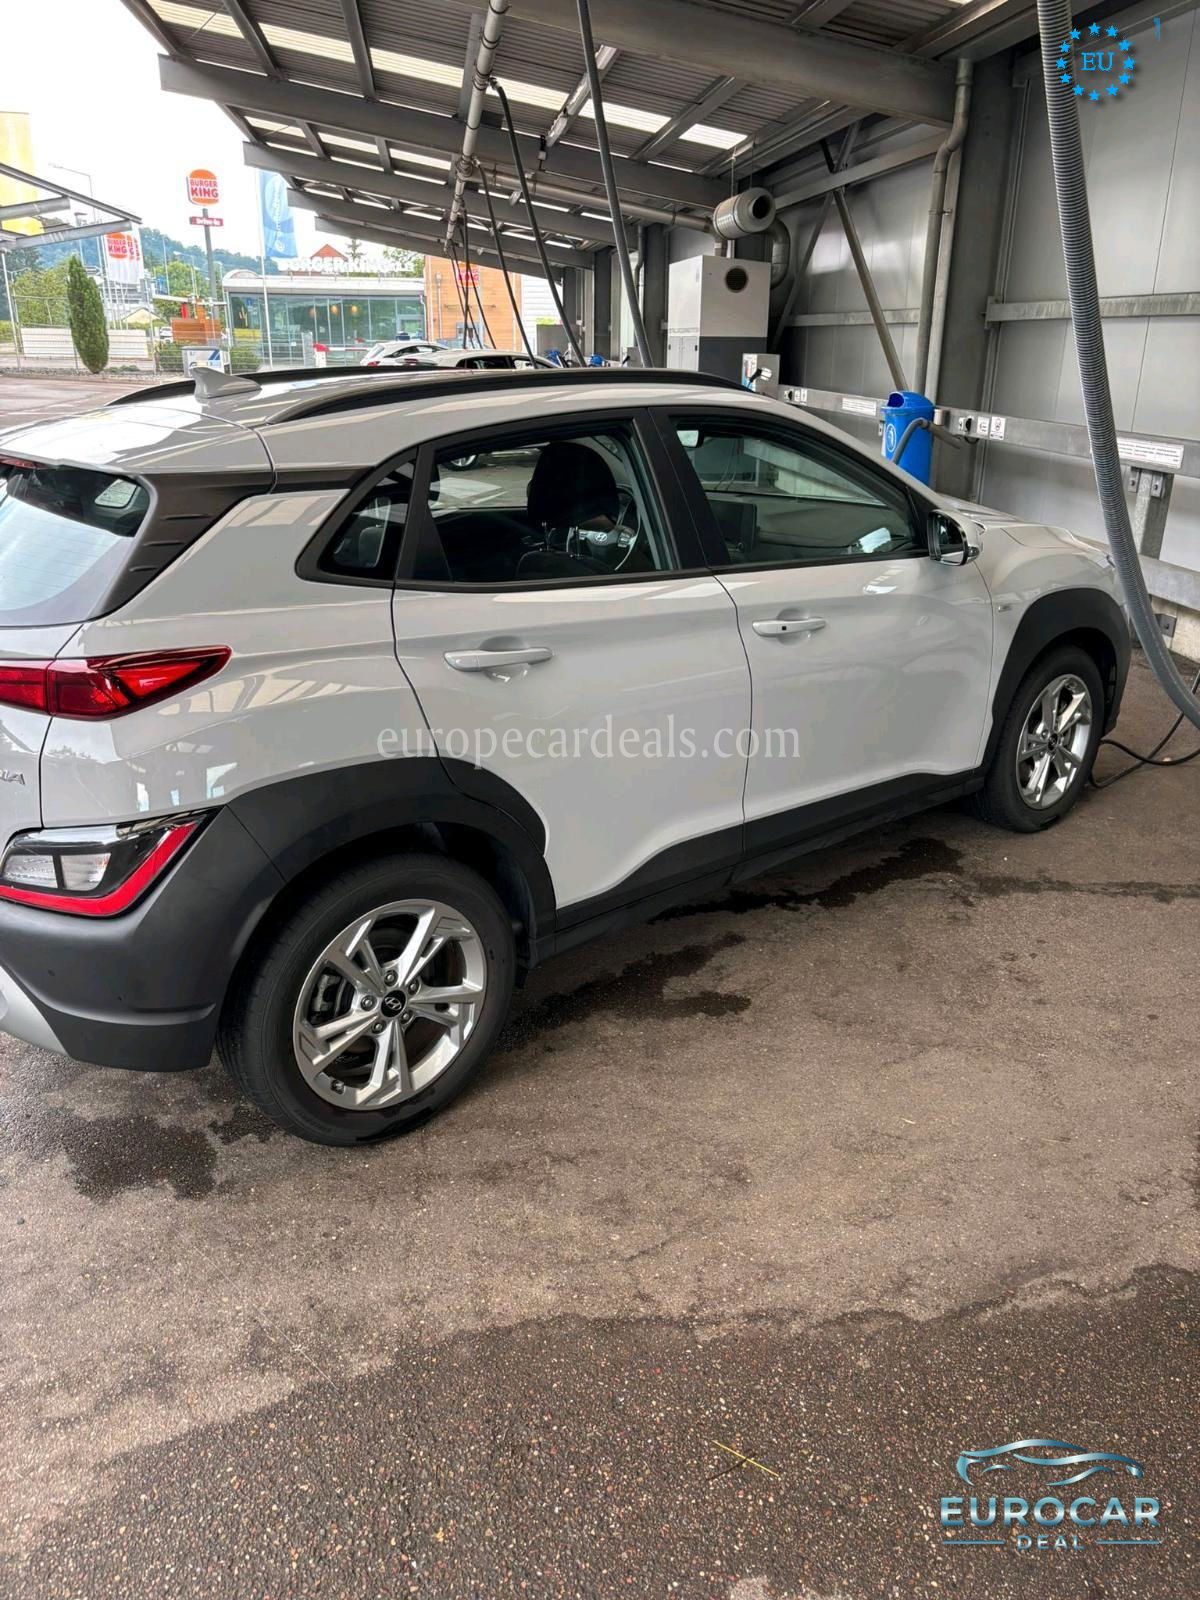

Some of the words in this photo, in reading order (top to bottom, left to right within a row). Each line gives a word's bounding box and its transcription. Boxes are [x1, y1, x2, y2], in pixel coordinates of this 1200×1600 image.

[190, 179, 218, 187] BURGER
[191, 187, 219, 198] KING
[108, 245, 127, 254] KING
